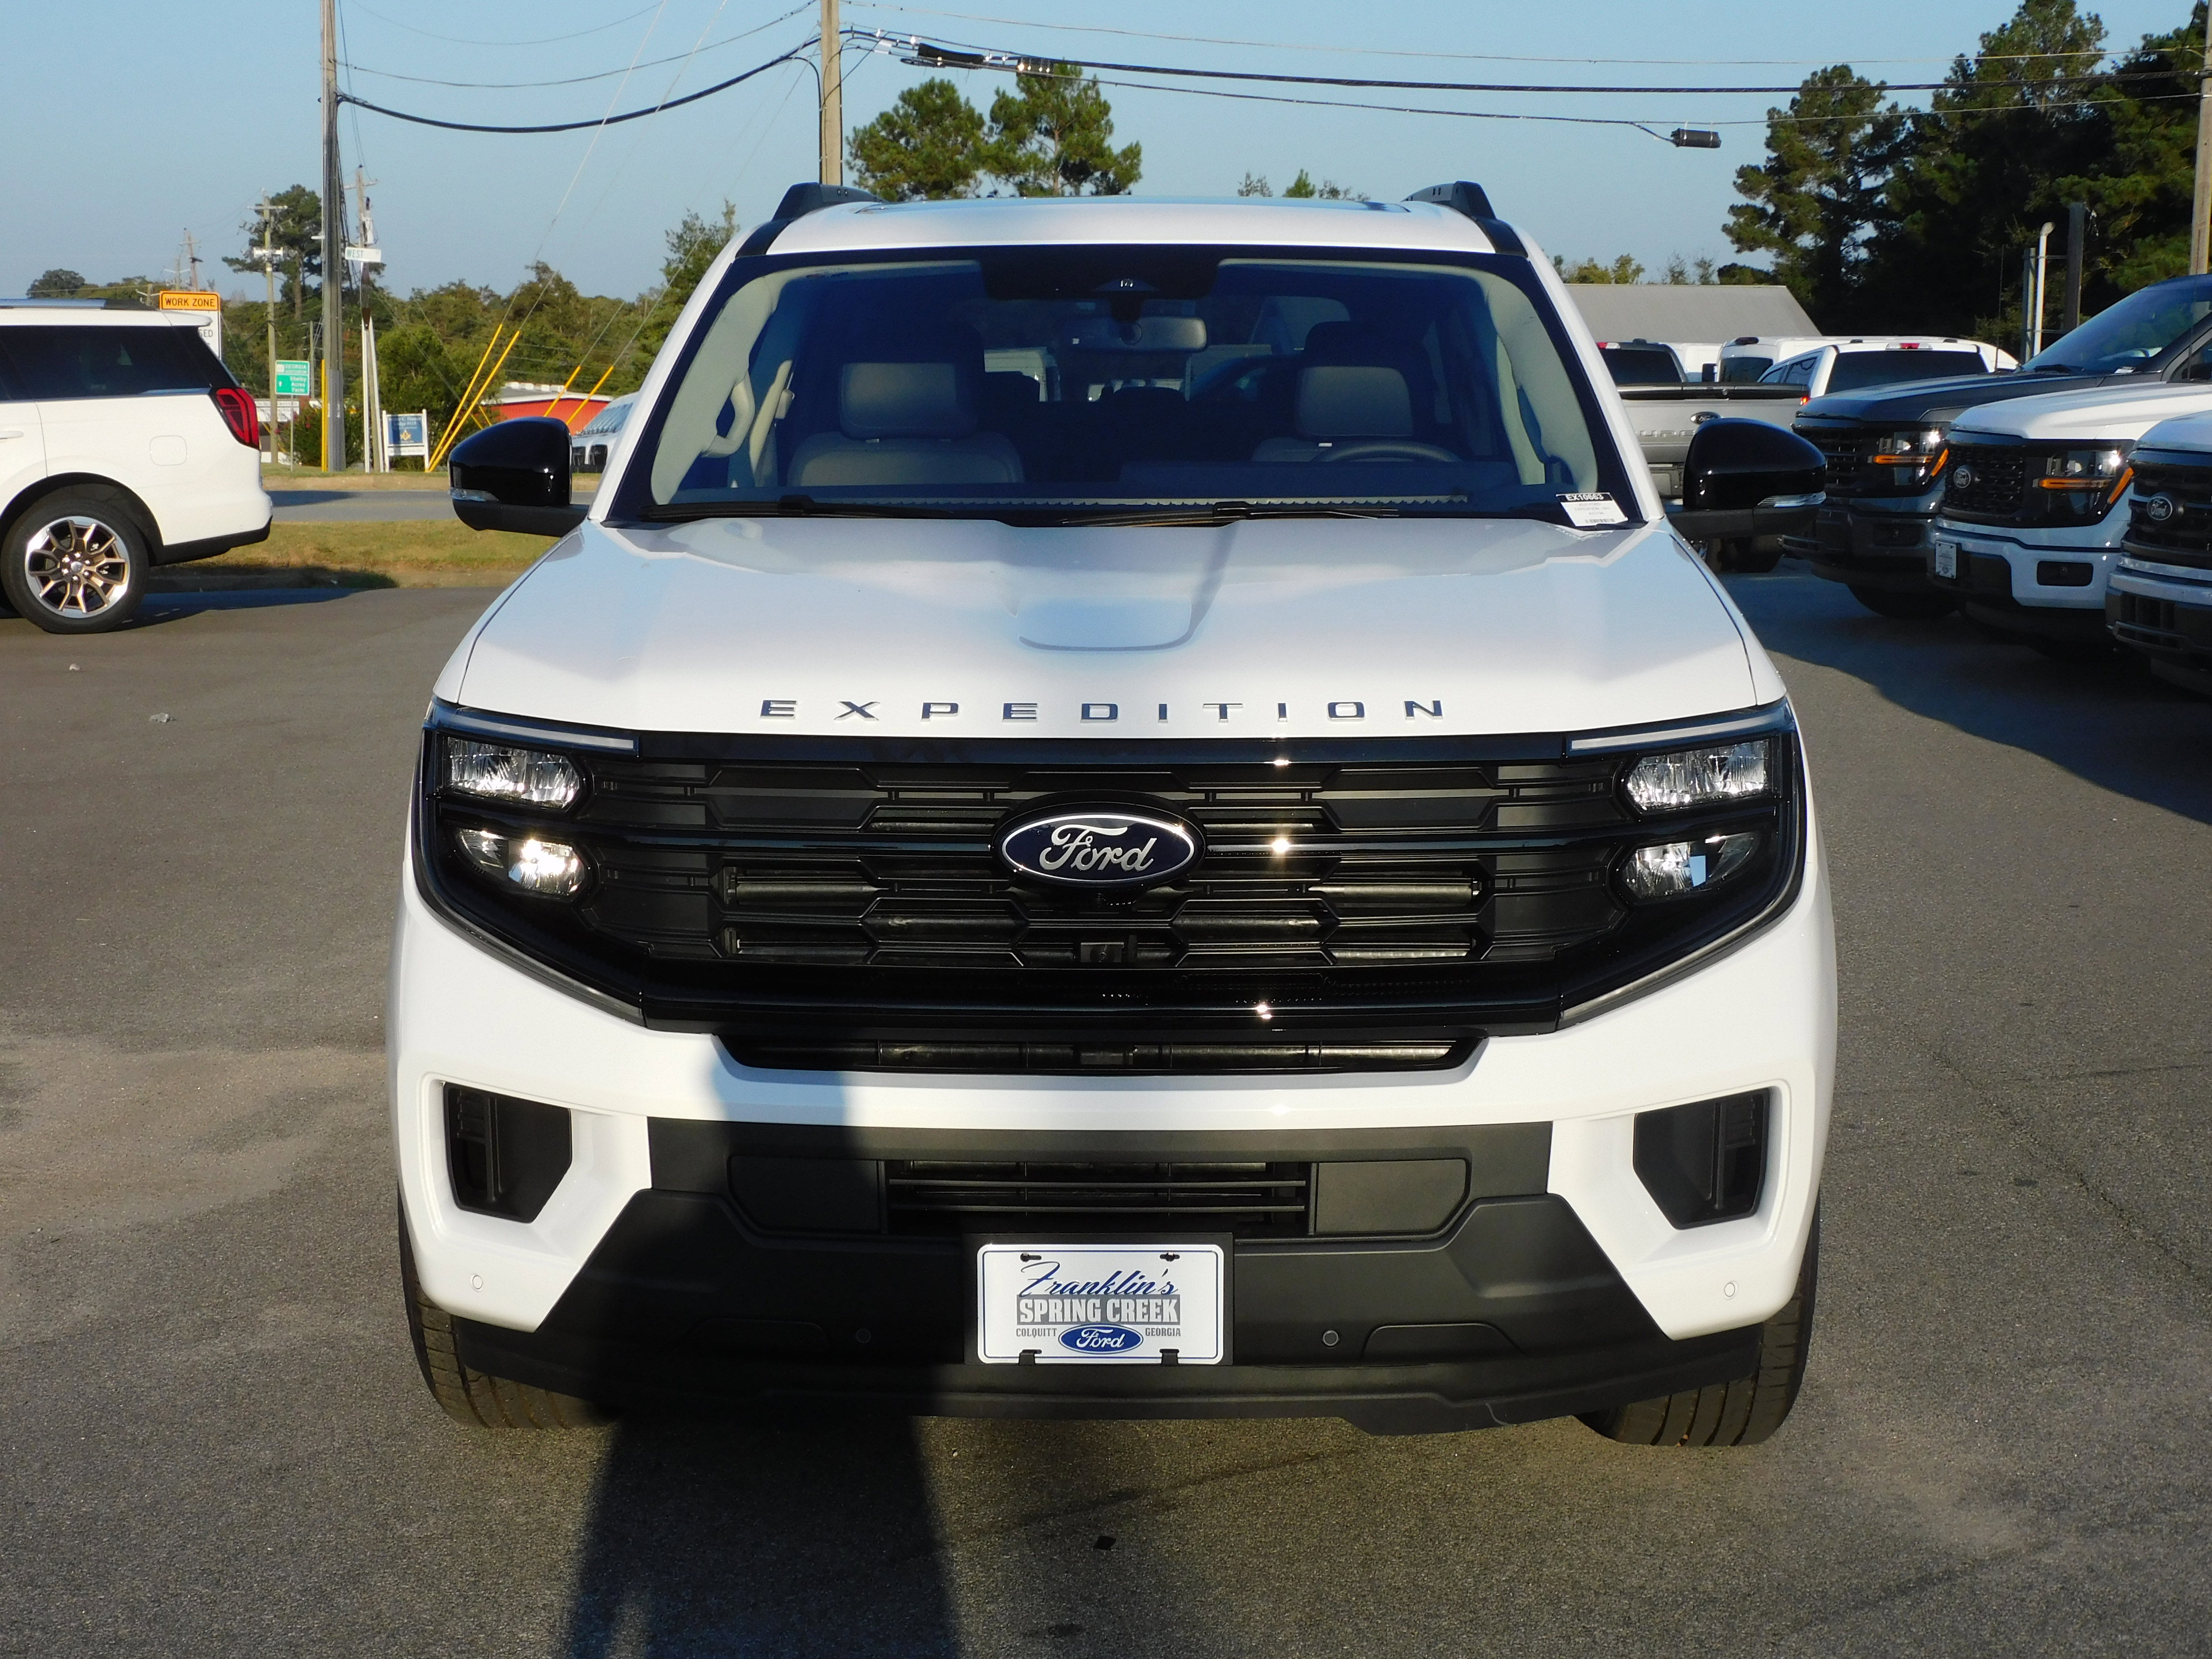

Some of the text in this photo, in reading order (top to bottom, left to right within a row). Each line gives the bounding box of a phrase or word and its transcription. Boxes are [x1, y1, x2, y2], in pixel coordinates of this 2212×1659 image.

[347, 249, 364, 259] WEST
[165, 298, 216, 307] WORK ZONE
[198, 329, 214, 337] SED
[2151, 499, 2167, 517] Ford
[760, 699, 1443, 724] EXPEDITION
[1039, 824, 1157, 871] Ford
[1019, 1261, 1179, 1297] Franklin's
[1020, 1298, 1178, 1323] SPRING CREEK
[1016, 1328, 1058, 1338] COLQUITT
[1076, 1328, 1126, 1348] Ford
[1145, 1327, 1181, 1337] GEORGIA
